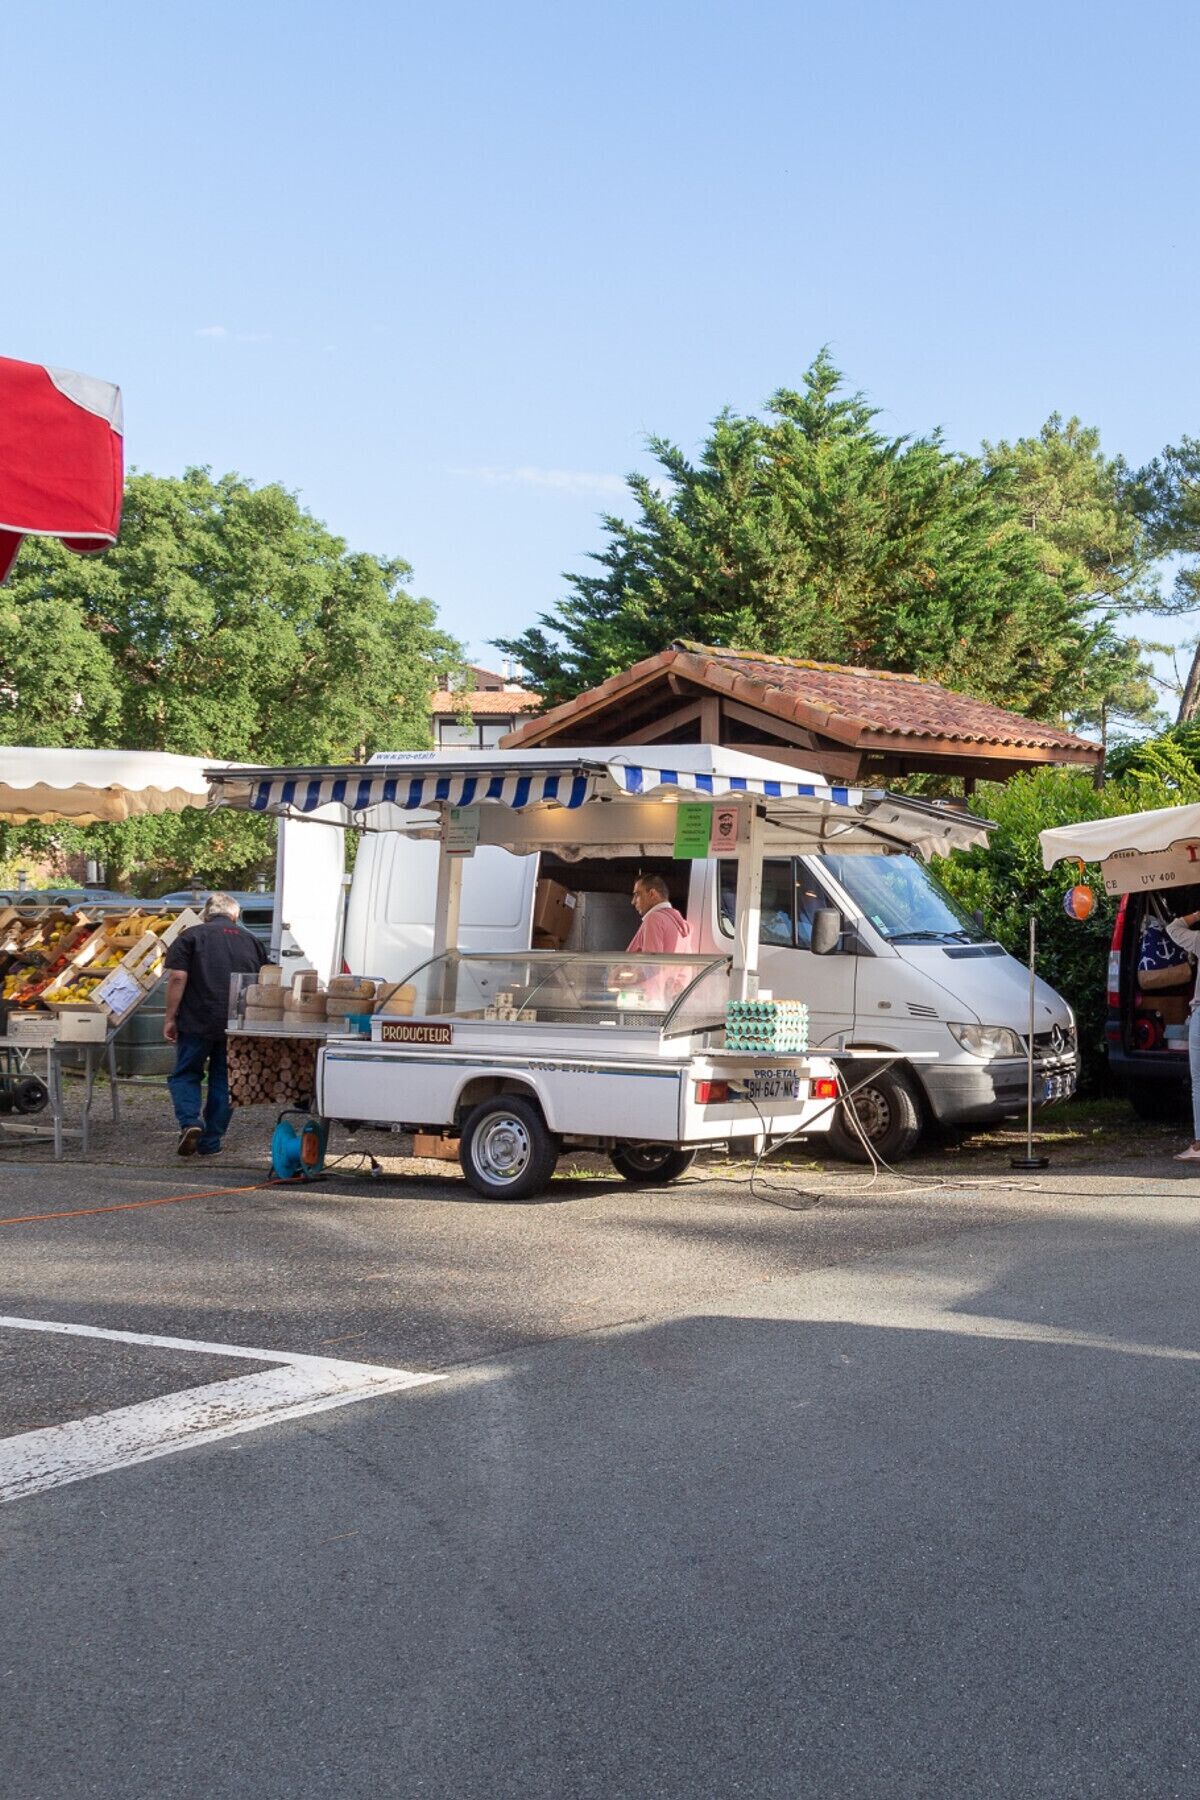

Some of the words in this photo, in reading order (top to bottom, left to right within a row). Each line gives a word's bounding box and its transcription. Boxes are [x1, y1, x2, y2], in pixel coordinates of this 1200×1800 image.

[1141, 874, 1156, 885] UV
[1159, 871, 1176, 881] 400
[1105, 880, 1118, 890] CE
[382, 1025, 450, 1042] PRODUCTEUR
[753, 1069, 798, 1079] PRO-ETAL
